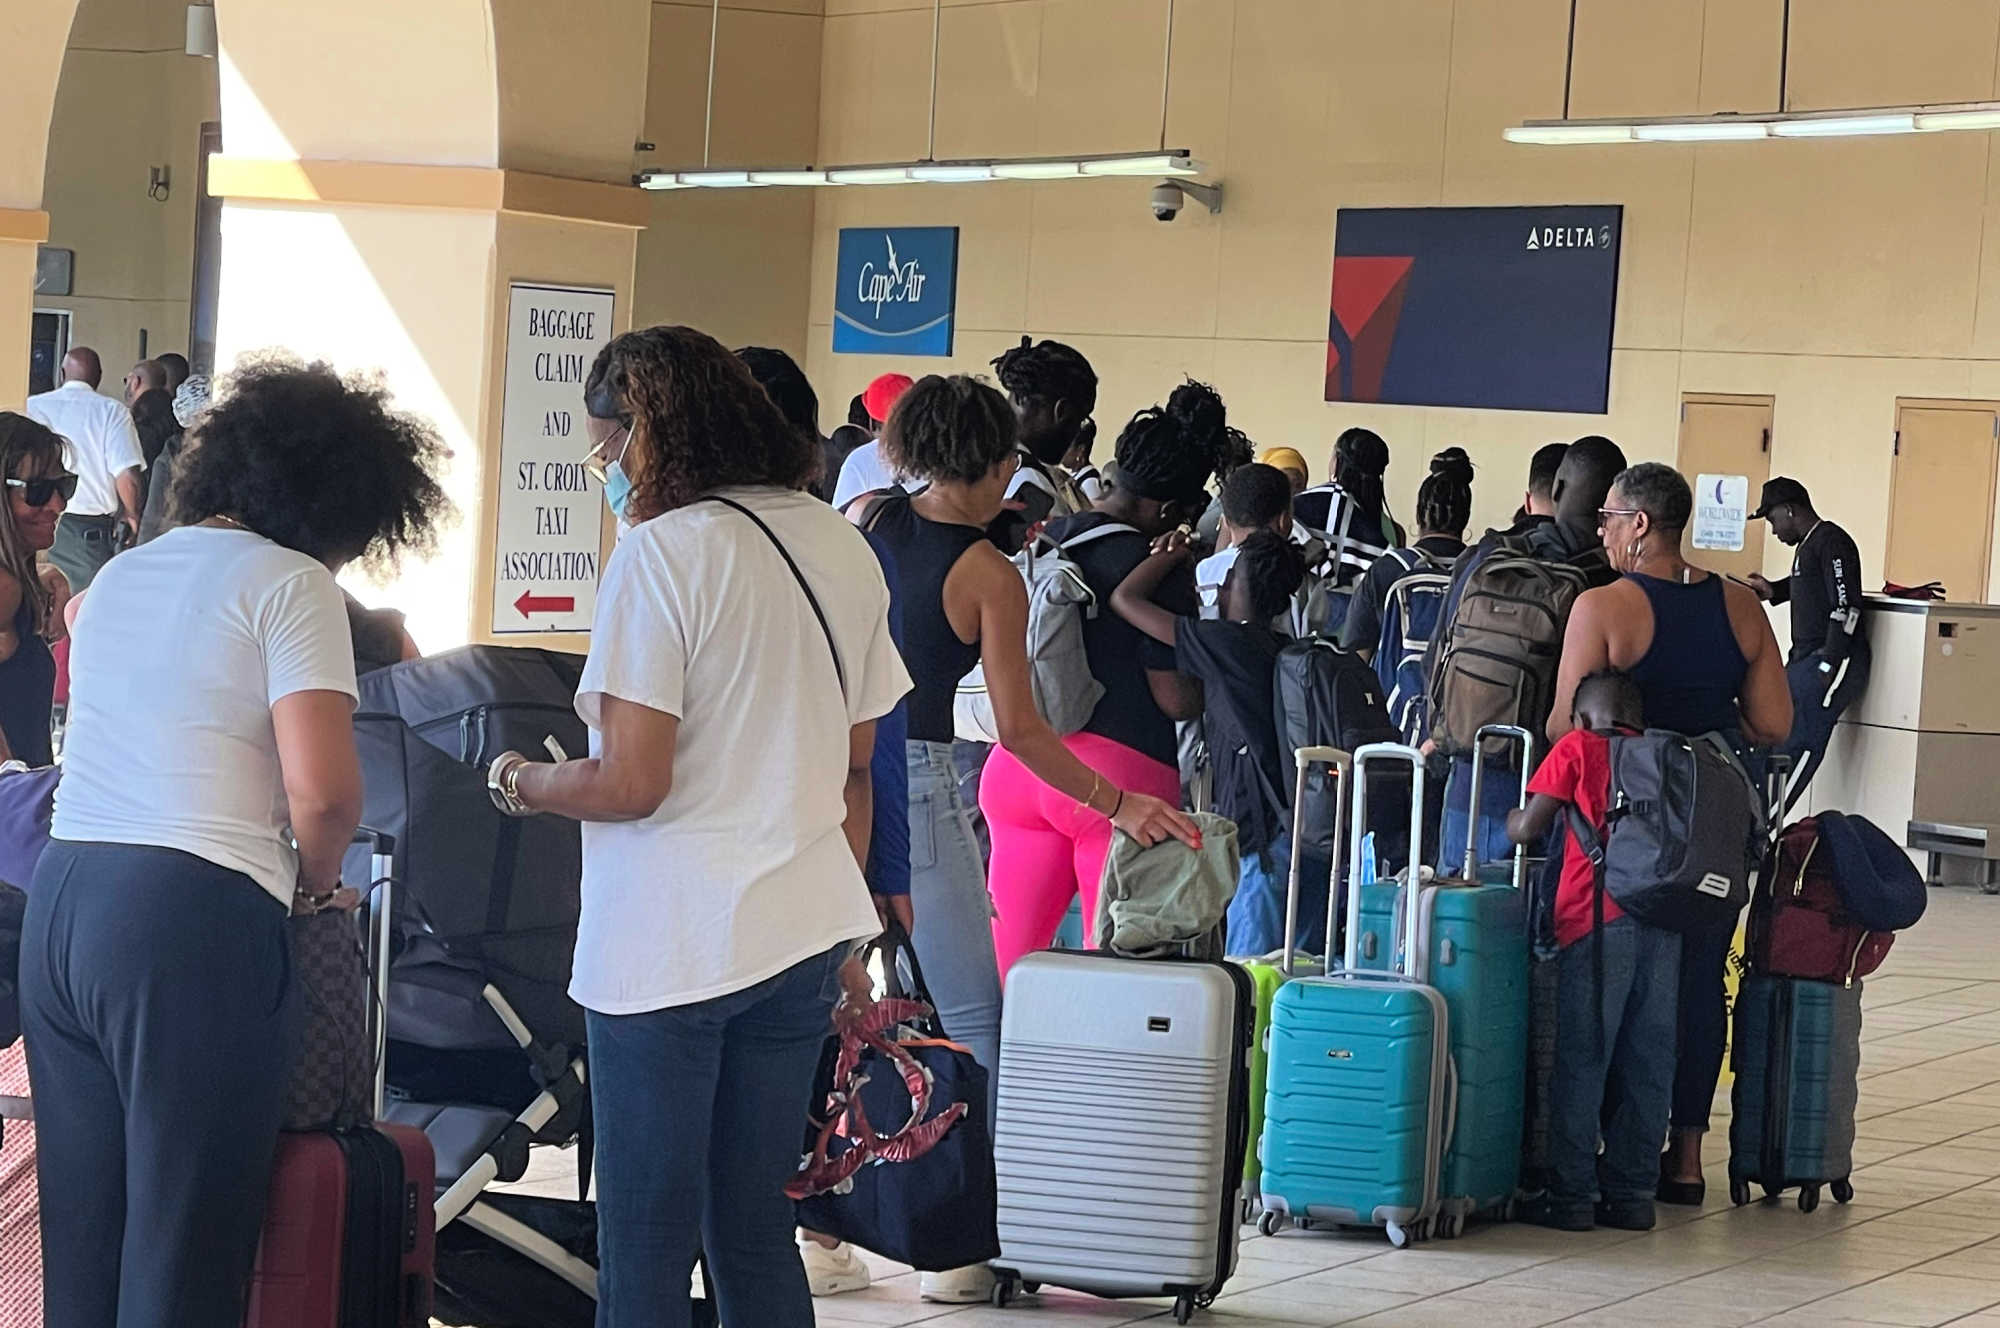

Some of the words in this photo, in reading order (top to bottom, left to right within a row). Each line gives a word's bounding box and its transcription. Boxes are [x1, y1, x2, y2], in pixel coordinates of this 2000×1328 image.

[1543, 227, 1595, 248] DELTA
[858, 261, 896, 320] Cape
[895, 258, 926, 302] Air
[529, 307, 595, 341] BAGGAGE
[535, 352, 584, 384] CLAIM
[542, 411, 571, 437] AND
[517, 462, 539, 491] ST.
[544, 462, 588, 492] CROIX
[535, 507, 569, 536] TAXI
[500, 551, 596, 581] ASSOCIATION
